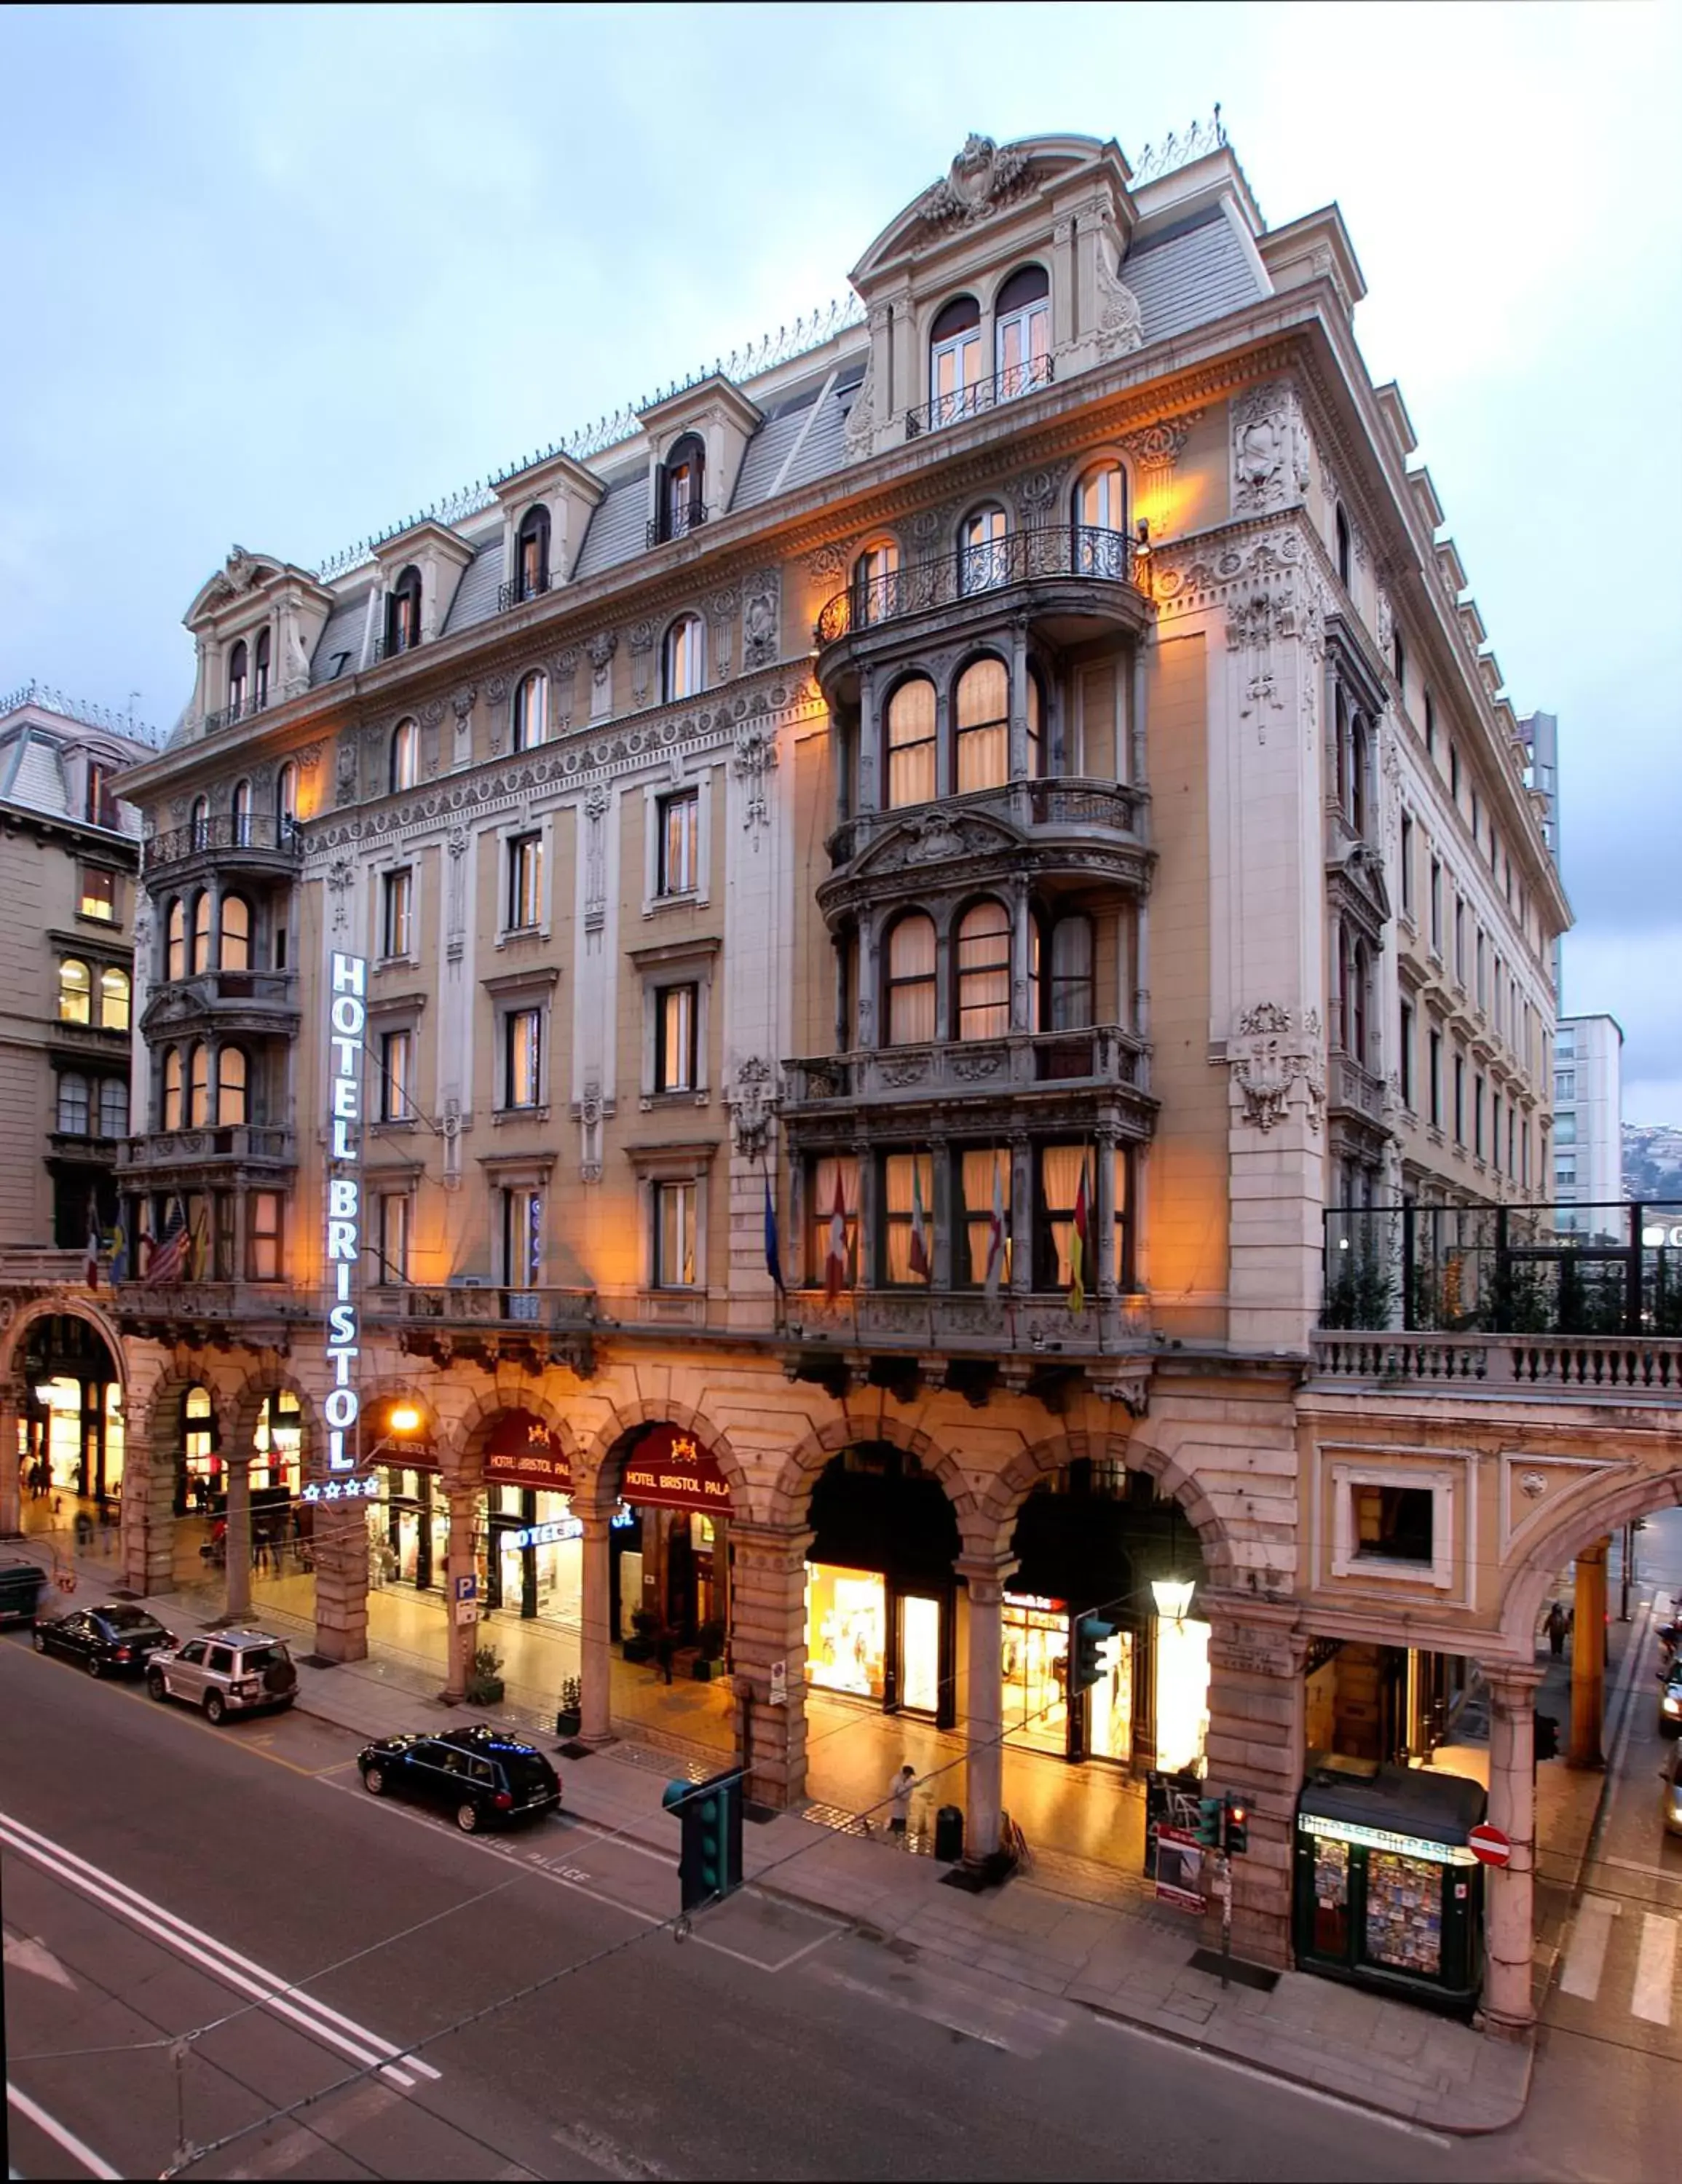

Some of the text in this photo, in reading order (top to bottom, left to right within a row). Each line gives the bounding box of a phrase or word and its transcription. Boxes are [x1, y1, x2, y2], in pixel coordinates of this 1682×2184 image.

[324, 953, 365, 1470] HOTEL BRISTOL
[491, 1455, 516, 1469] HOTEL
[518, 1457, 552, 1473] BRISTOL
[626, 1471, 730, 1495] HOTEL BRISTOL PALA
[459, 1578, 473, 1598] P
[526, 1852, 591, 1883] PALACE
